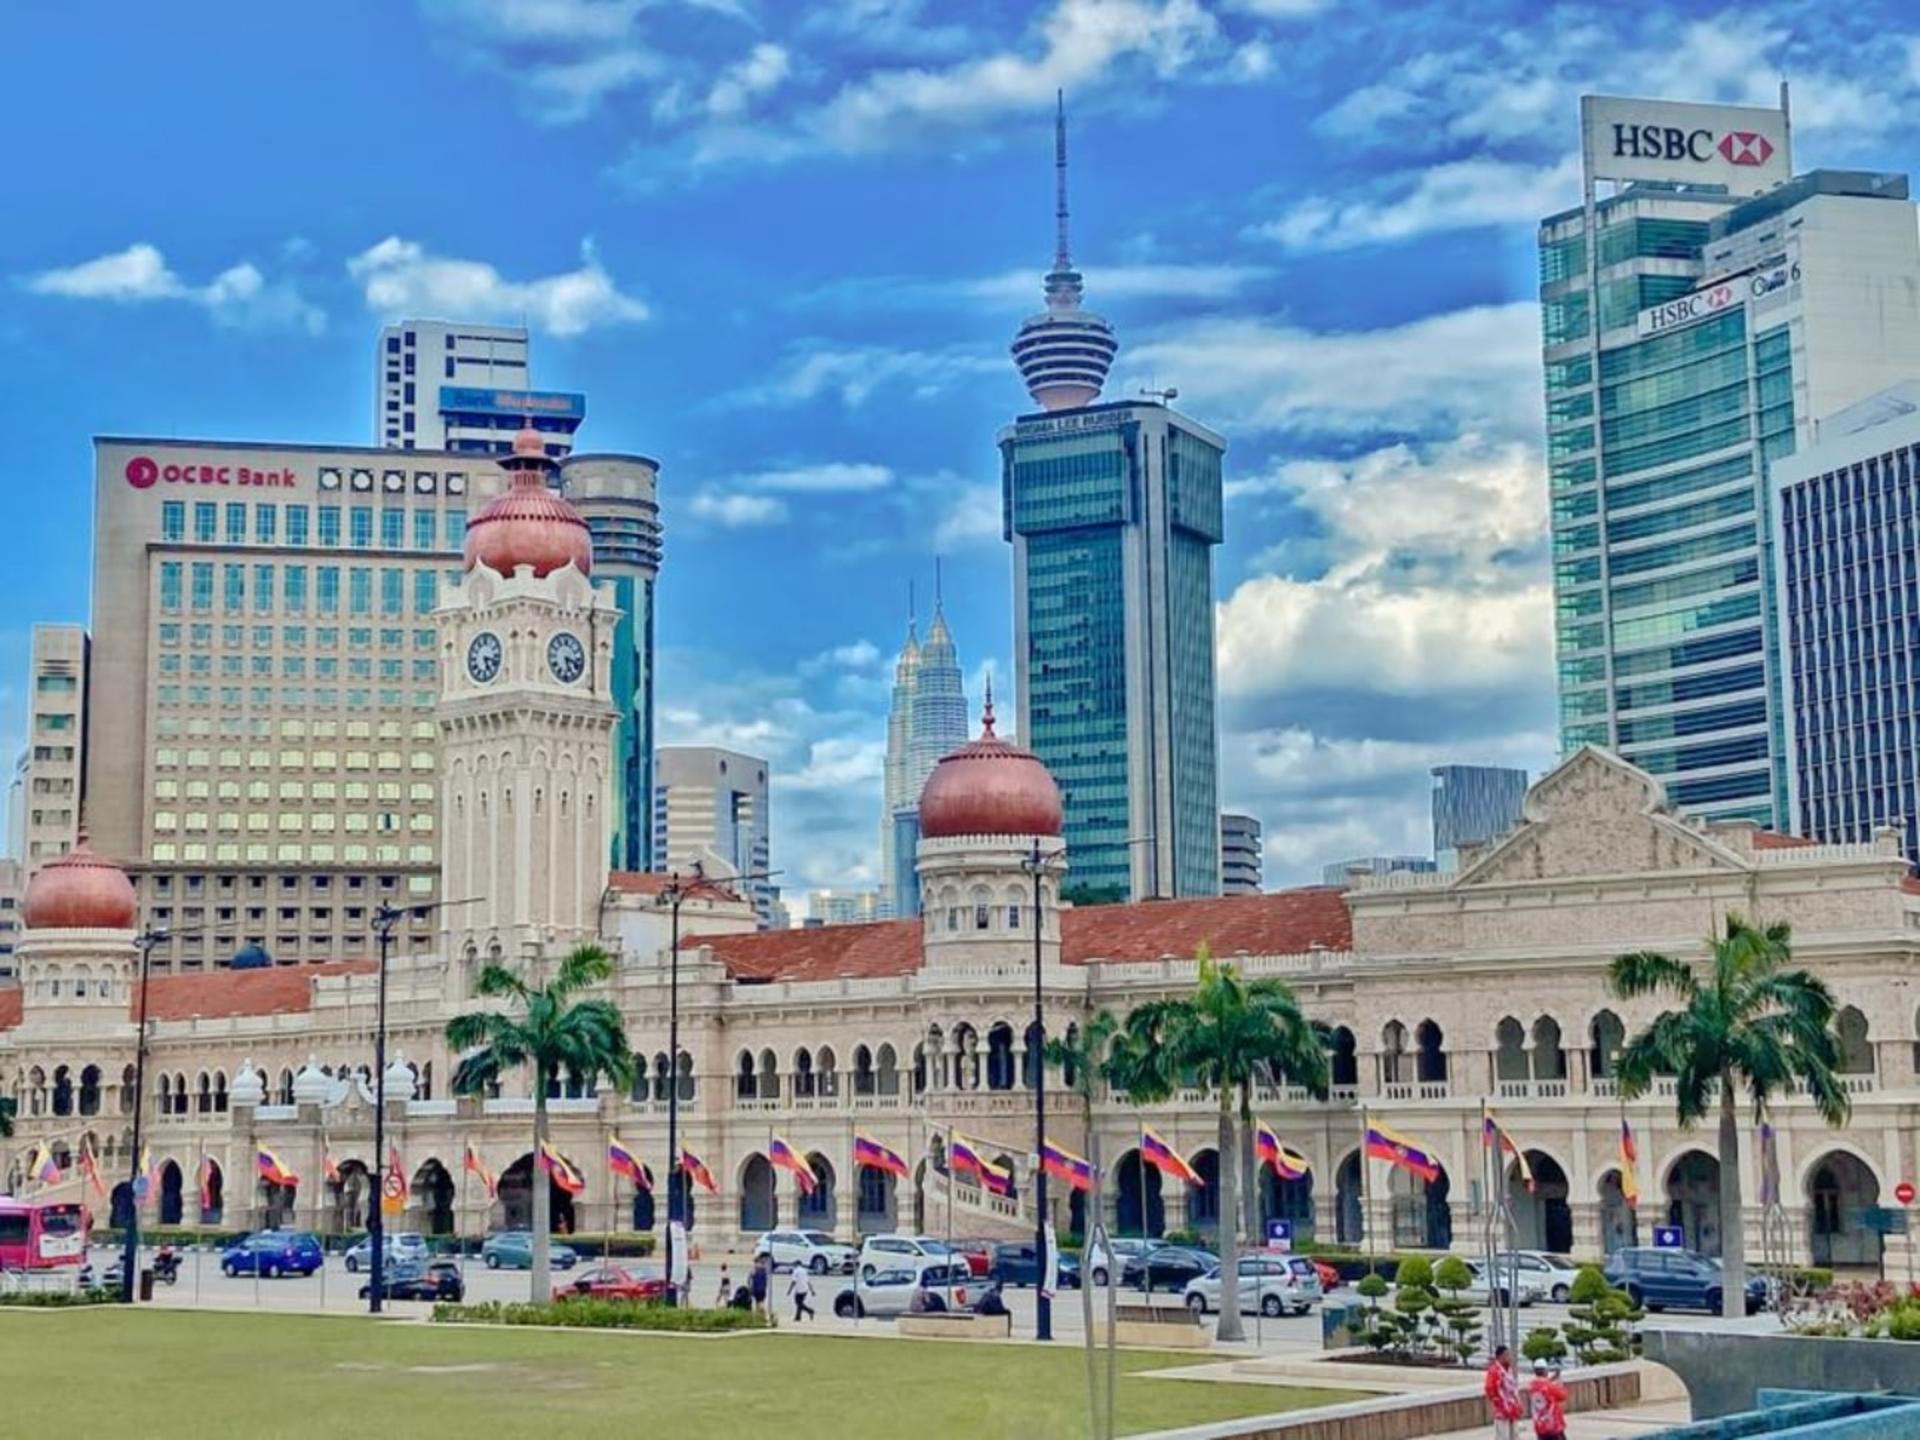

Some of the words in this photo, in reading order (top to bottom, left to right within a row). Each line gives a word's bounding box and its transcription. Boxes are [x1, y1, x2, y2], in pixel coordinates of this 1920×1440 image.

[1613, 124, 1713, 162] HSBC
[1791, 261, 1801, 281] 6
[1651, 296, 1702, 329] HSBC
[163, 464, 230, 485] OCBC
[237, 467, 296, 488] Bank
